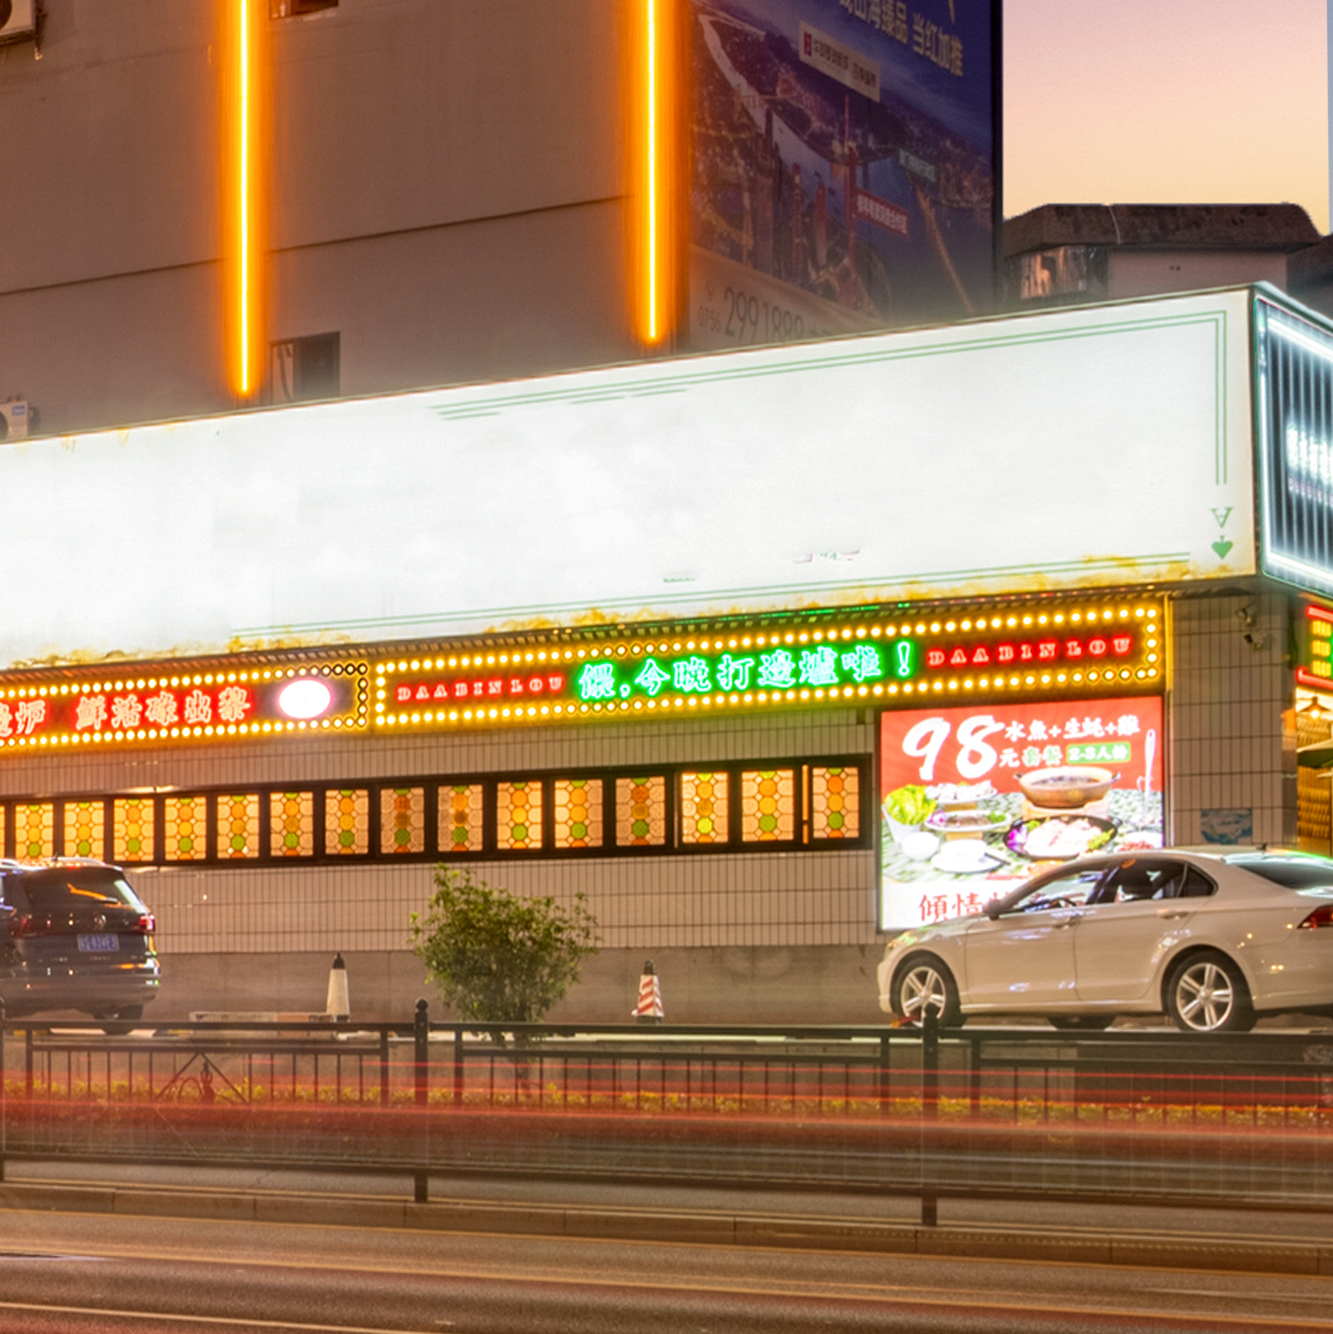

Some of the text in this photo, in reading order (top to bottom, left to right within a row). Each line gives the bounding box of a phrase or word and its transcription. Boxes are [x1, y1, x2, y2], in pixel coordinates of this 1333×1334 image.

[928, 637, 1131, 666] DAA BIN LOU
[397, 676, 563, 702] DAA BIN LOU
[902, 715, 1006, 781] 98
